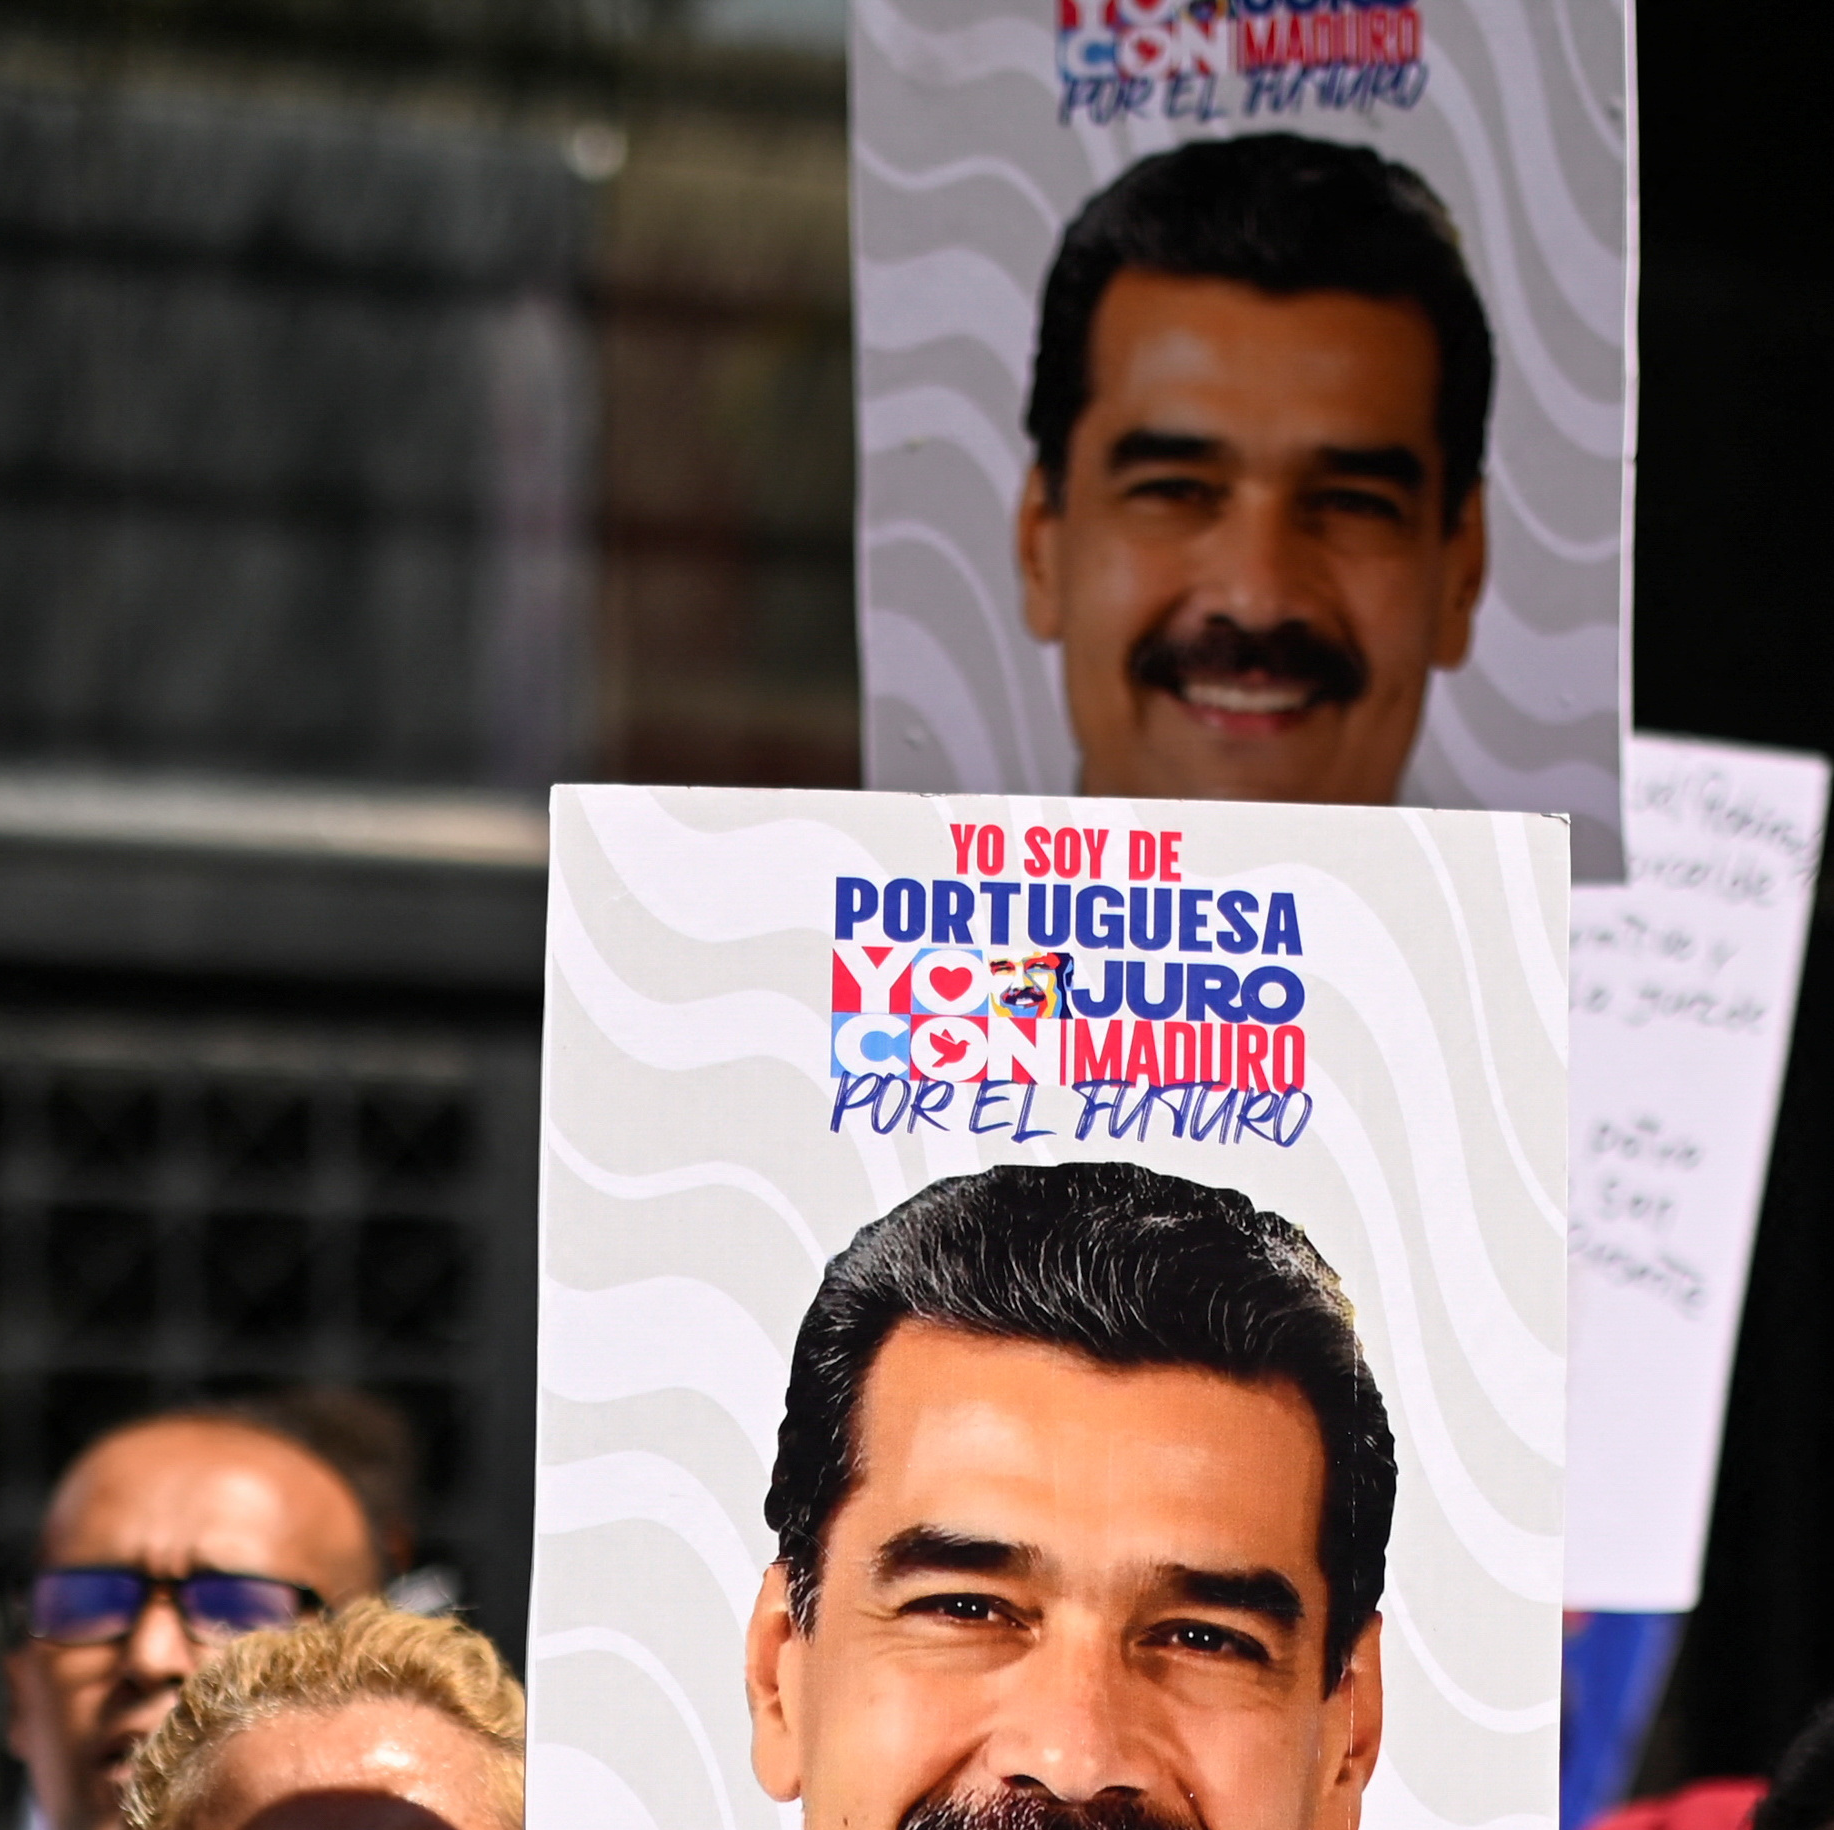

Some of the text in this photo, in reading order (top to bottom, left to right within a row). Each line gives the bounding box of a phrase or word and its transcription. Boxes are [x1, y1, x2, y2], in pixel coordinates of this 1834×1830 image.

[1243, 7, 1423, 71] MADURO
[1058, 75, 1155, 126] POR
[1165, 72, 1228, 122] EL
[949, 823, 1183, 883] YO SOY DE
[835, 876, 1303, 957] PORTUGUESA
[832, 945, 1306, 1025] YO JURO
[833, 1013, 1306, 1094] CON MADURO
[830, 1070, 1313, 1148] POR EL FUTURO
